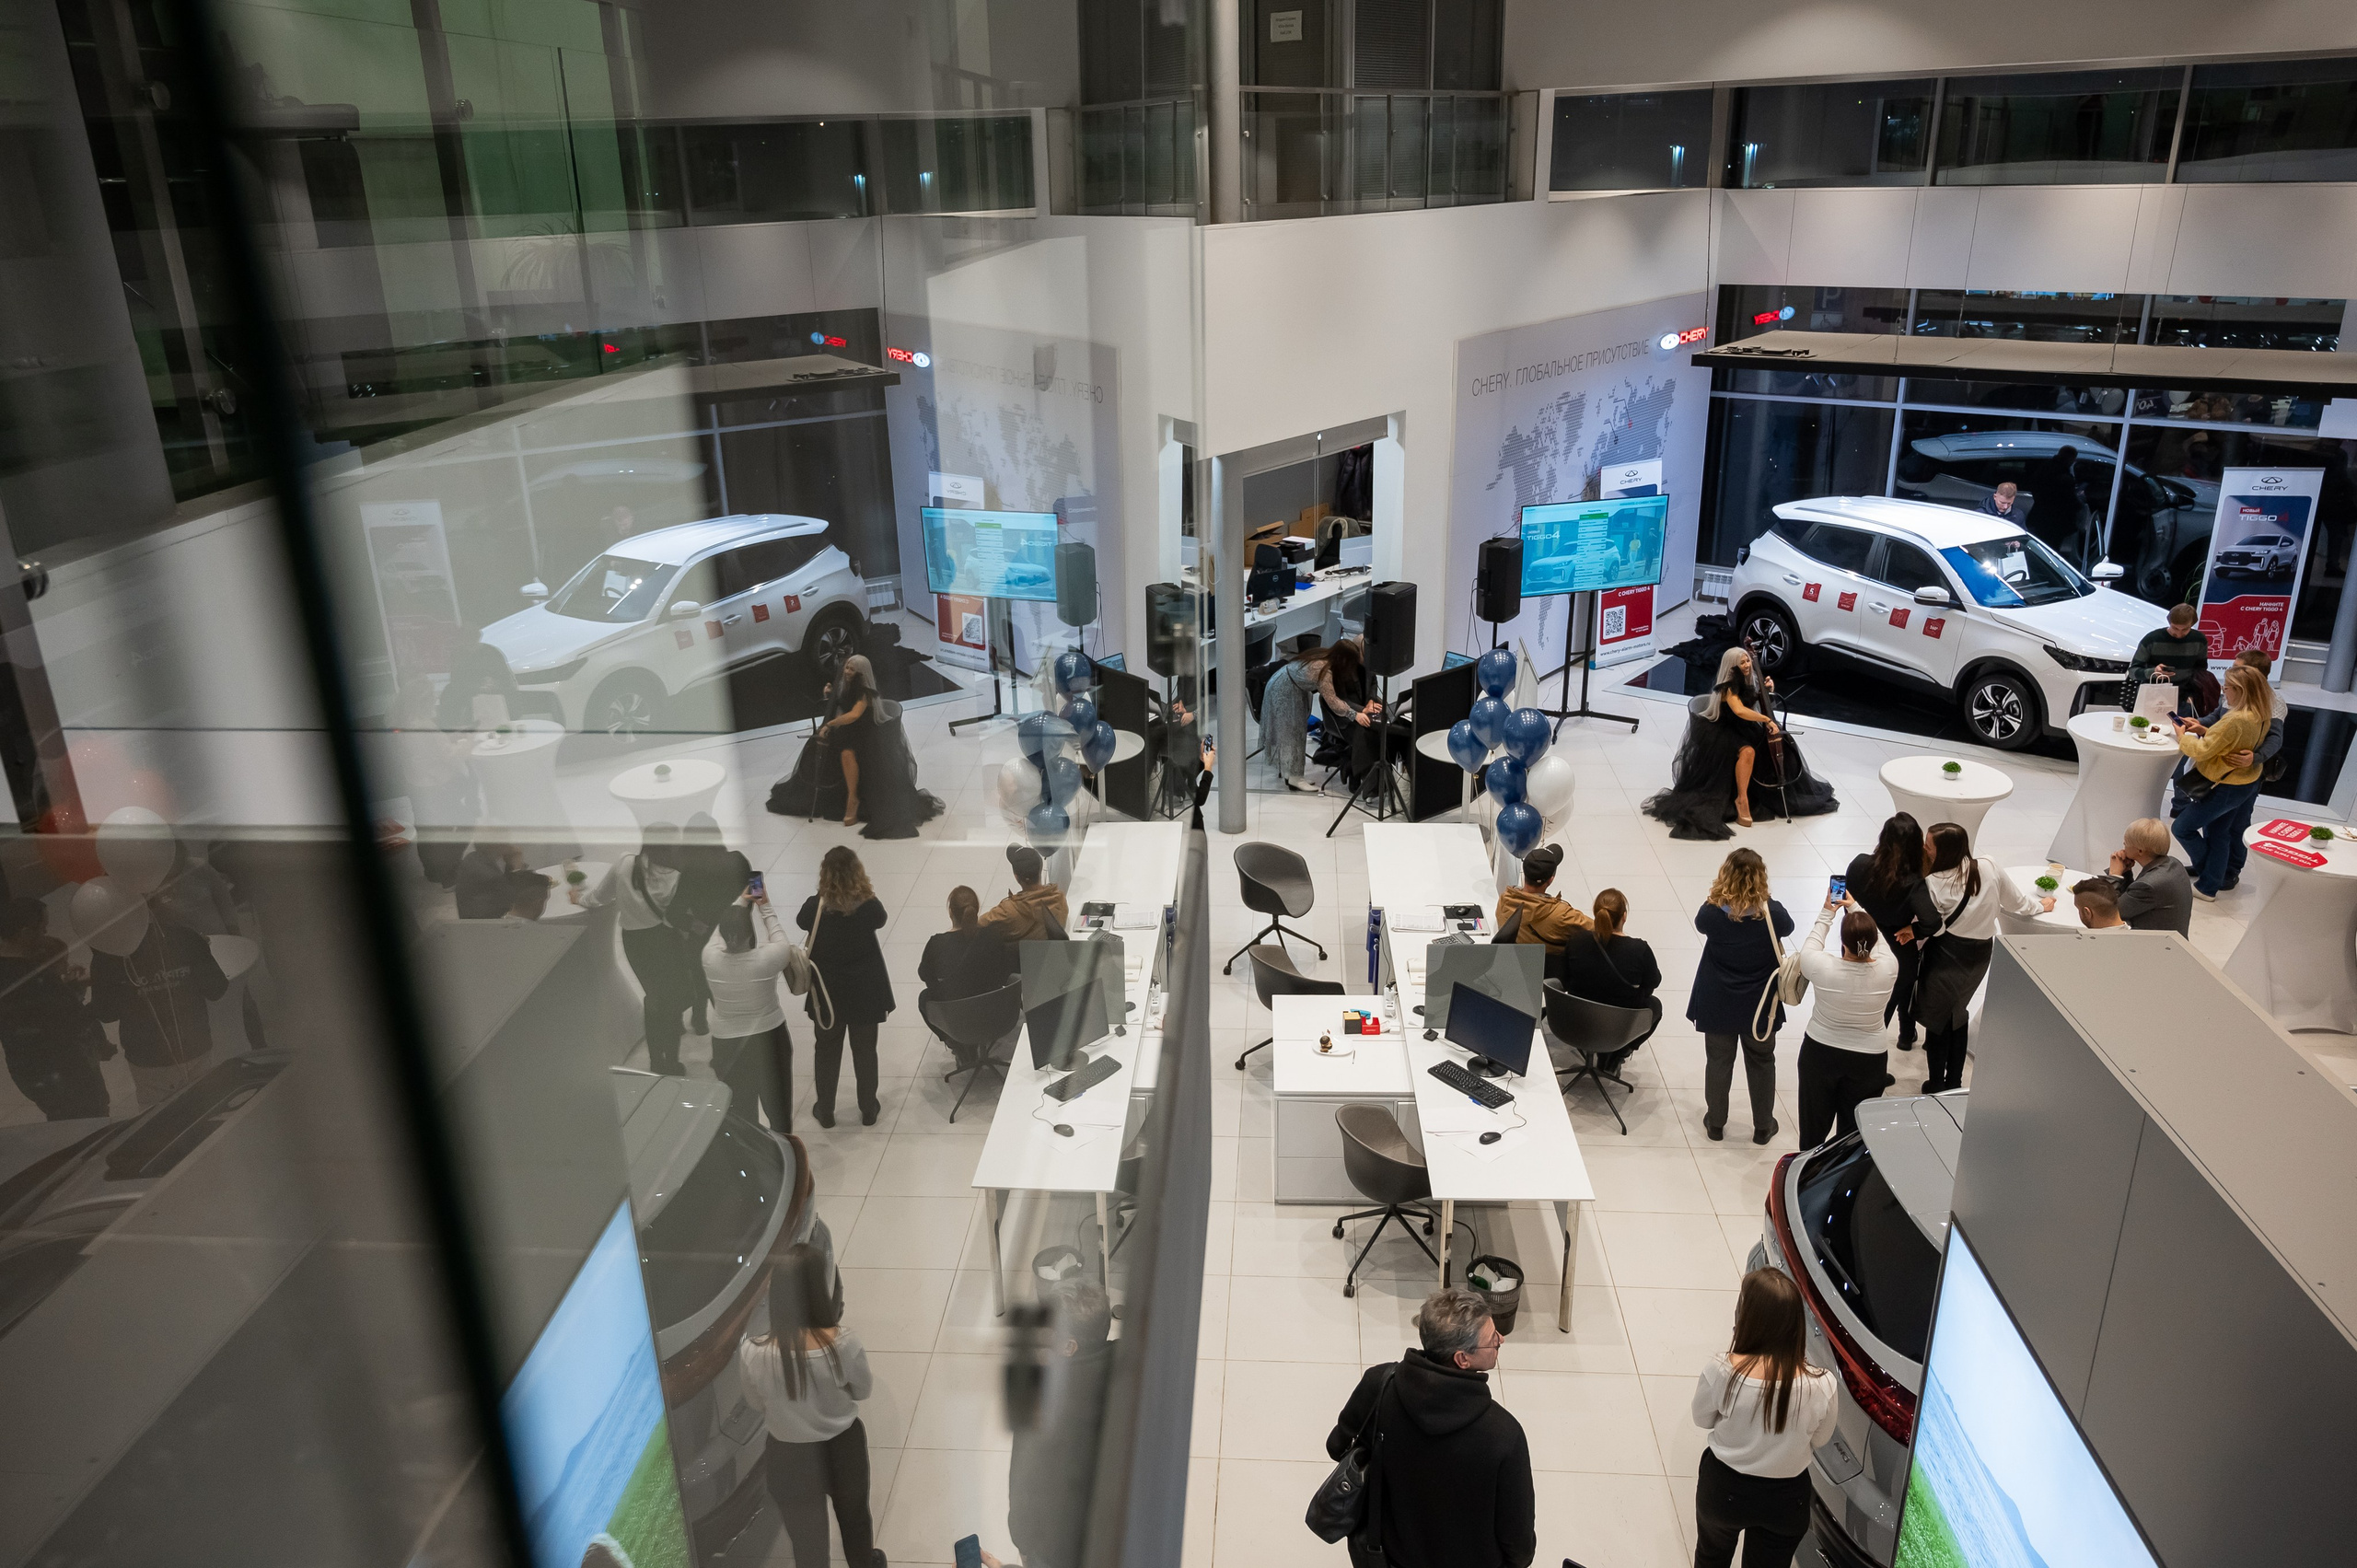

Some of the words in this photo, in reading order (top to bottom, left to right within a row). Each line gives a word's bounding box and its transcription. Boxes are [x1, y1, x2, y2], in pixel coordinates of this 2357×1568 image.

[1679, 326, 1710, 344] CHERY
[1472, 371, 1512, 396] CHERY.
[1515, 354, 1584, 386] ГЛОБАЛЬНОЕ
[1585, 339, 1650, 368] ПРИСУТСТВИЕ
